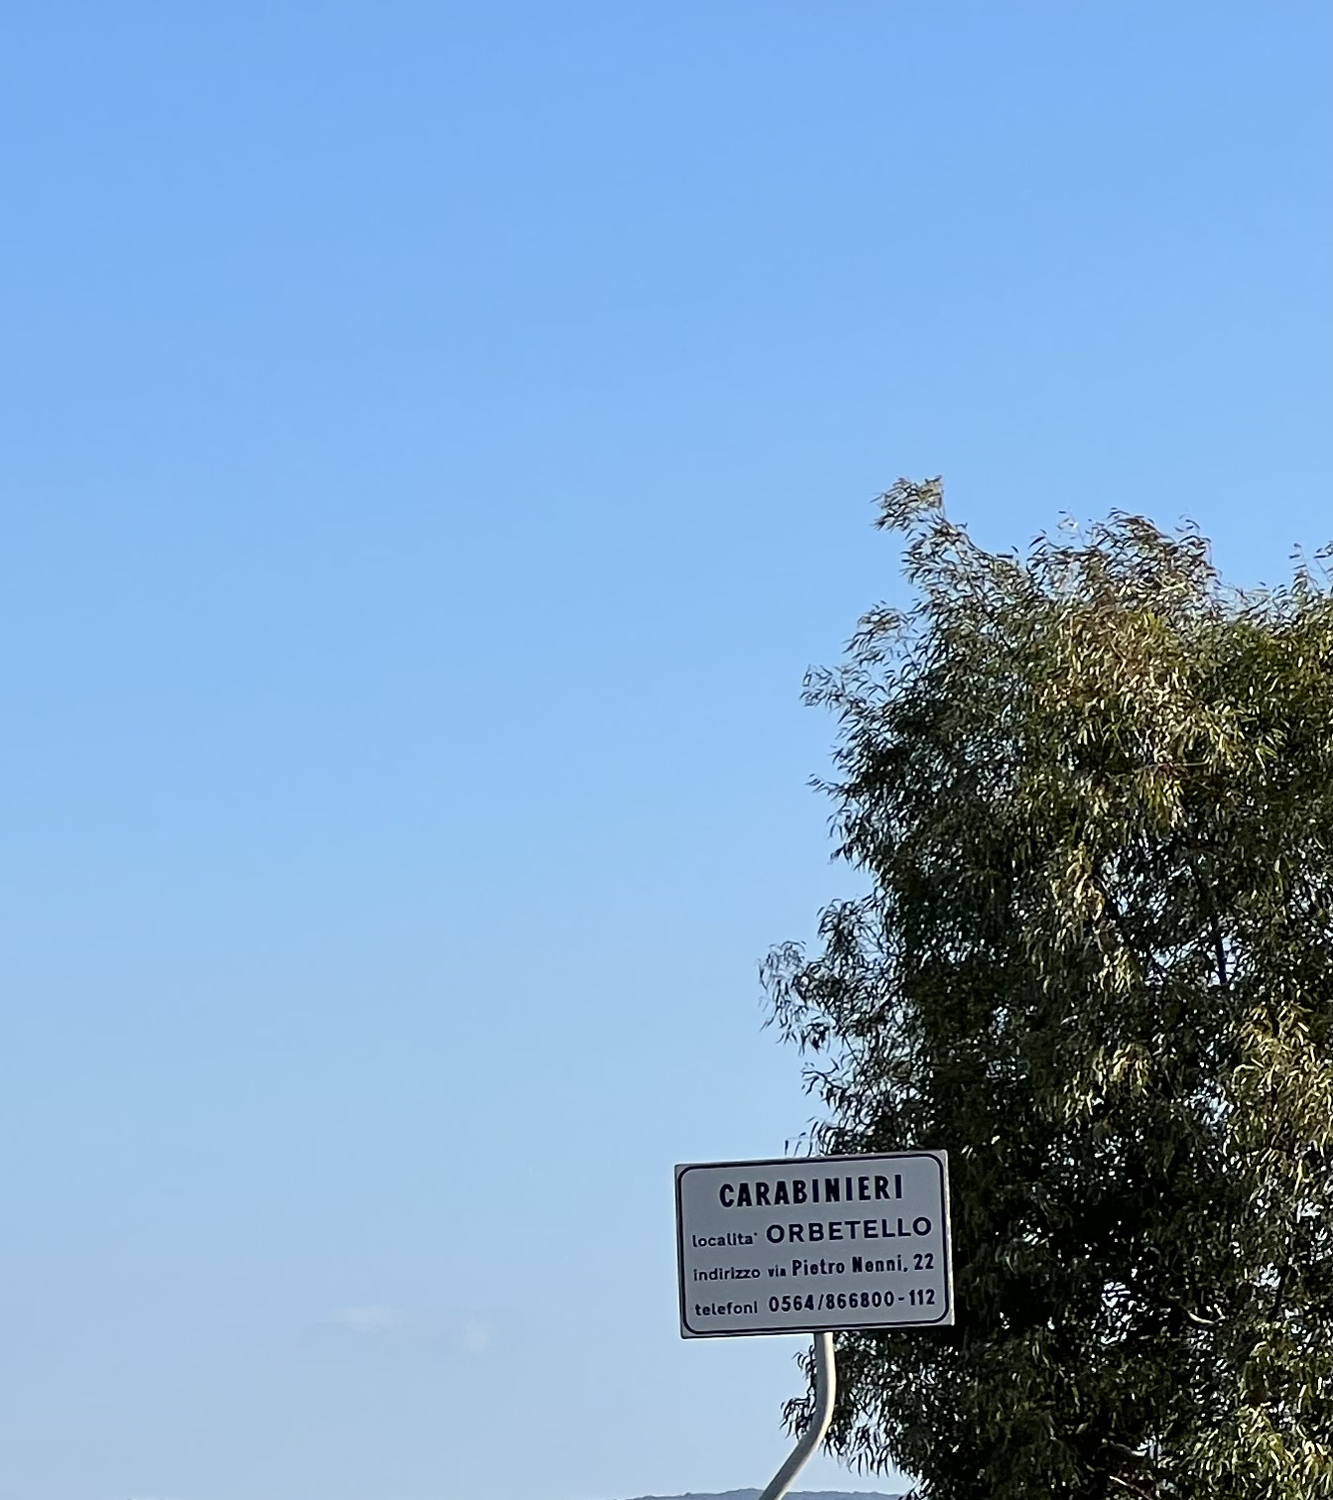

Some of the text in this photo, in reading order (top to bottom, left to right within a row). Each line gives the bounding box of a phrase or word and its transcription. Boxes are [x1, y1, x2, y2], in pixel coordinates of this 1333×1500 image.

[719, 1174, 902, 1208] CARABINIERI
[766, 1216, 932, 1244] ORBETELLO
[693, 1252, 934, 1281] indirizzo via Pietro Nenni, 22
[695, 1300, 758, 1316] telefoni
